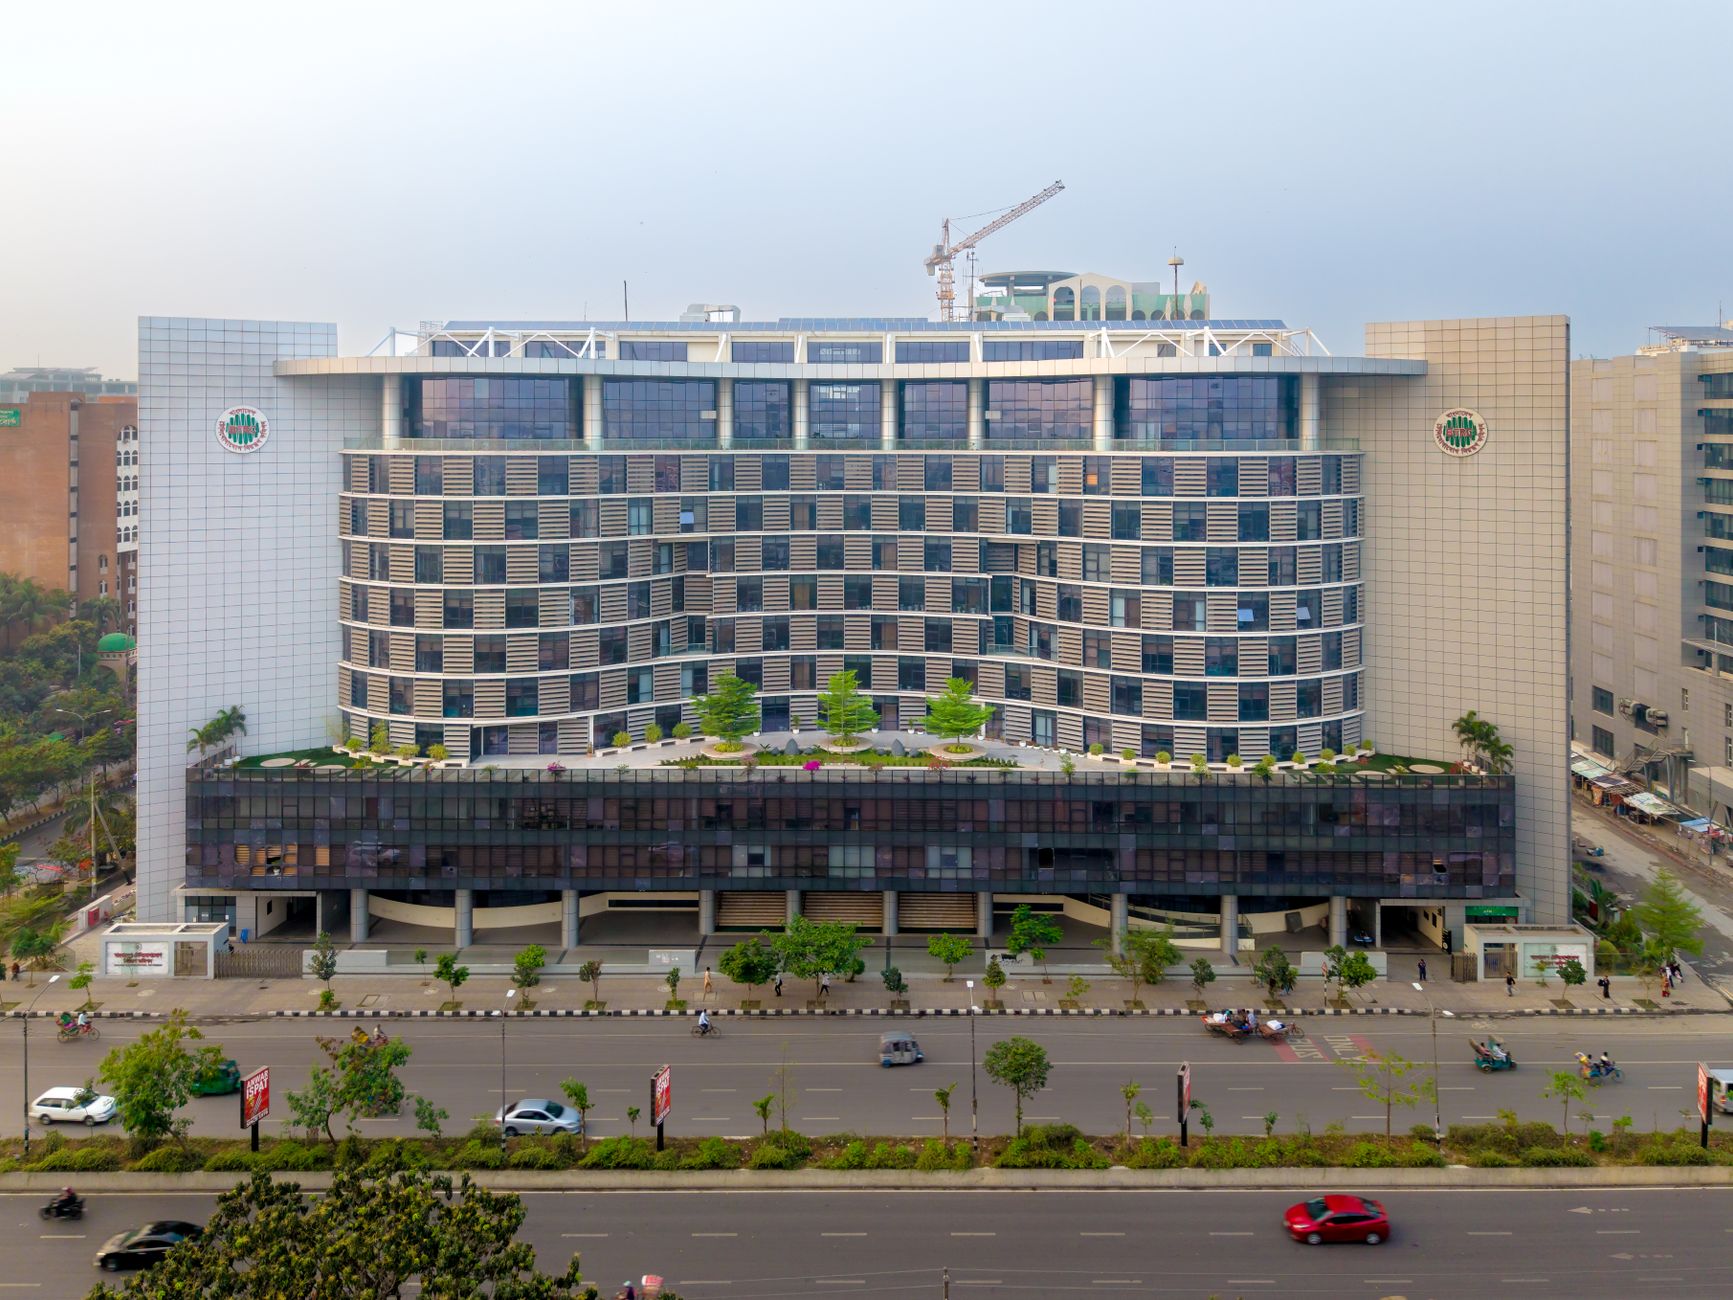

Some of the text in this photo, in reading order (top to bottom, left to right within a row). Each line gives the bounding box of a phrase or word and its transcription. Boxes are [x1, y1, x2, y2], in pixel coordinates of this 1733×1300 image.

[1446, 428, 1472, 437] BTRC
[1287, 1038, 1323, 1058] BUS
[1323, 1035, 1368, 1061] ONLY
[246, 1079, 267, 1099] ISPAT
[247, 1071, 268, 1088] ANWAR
